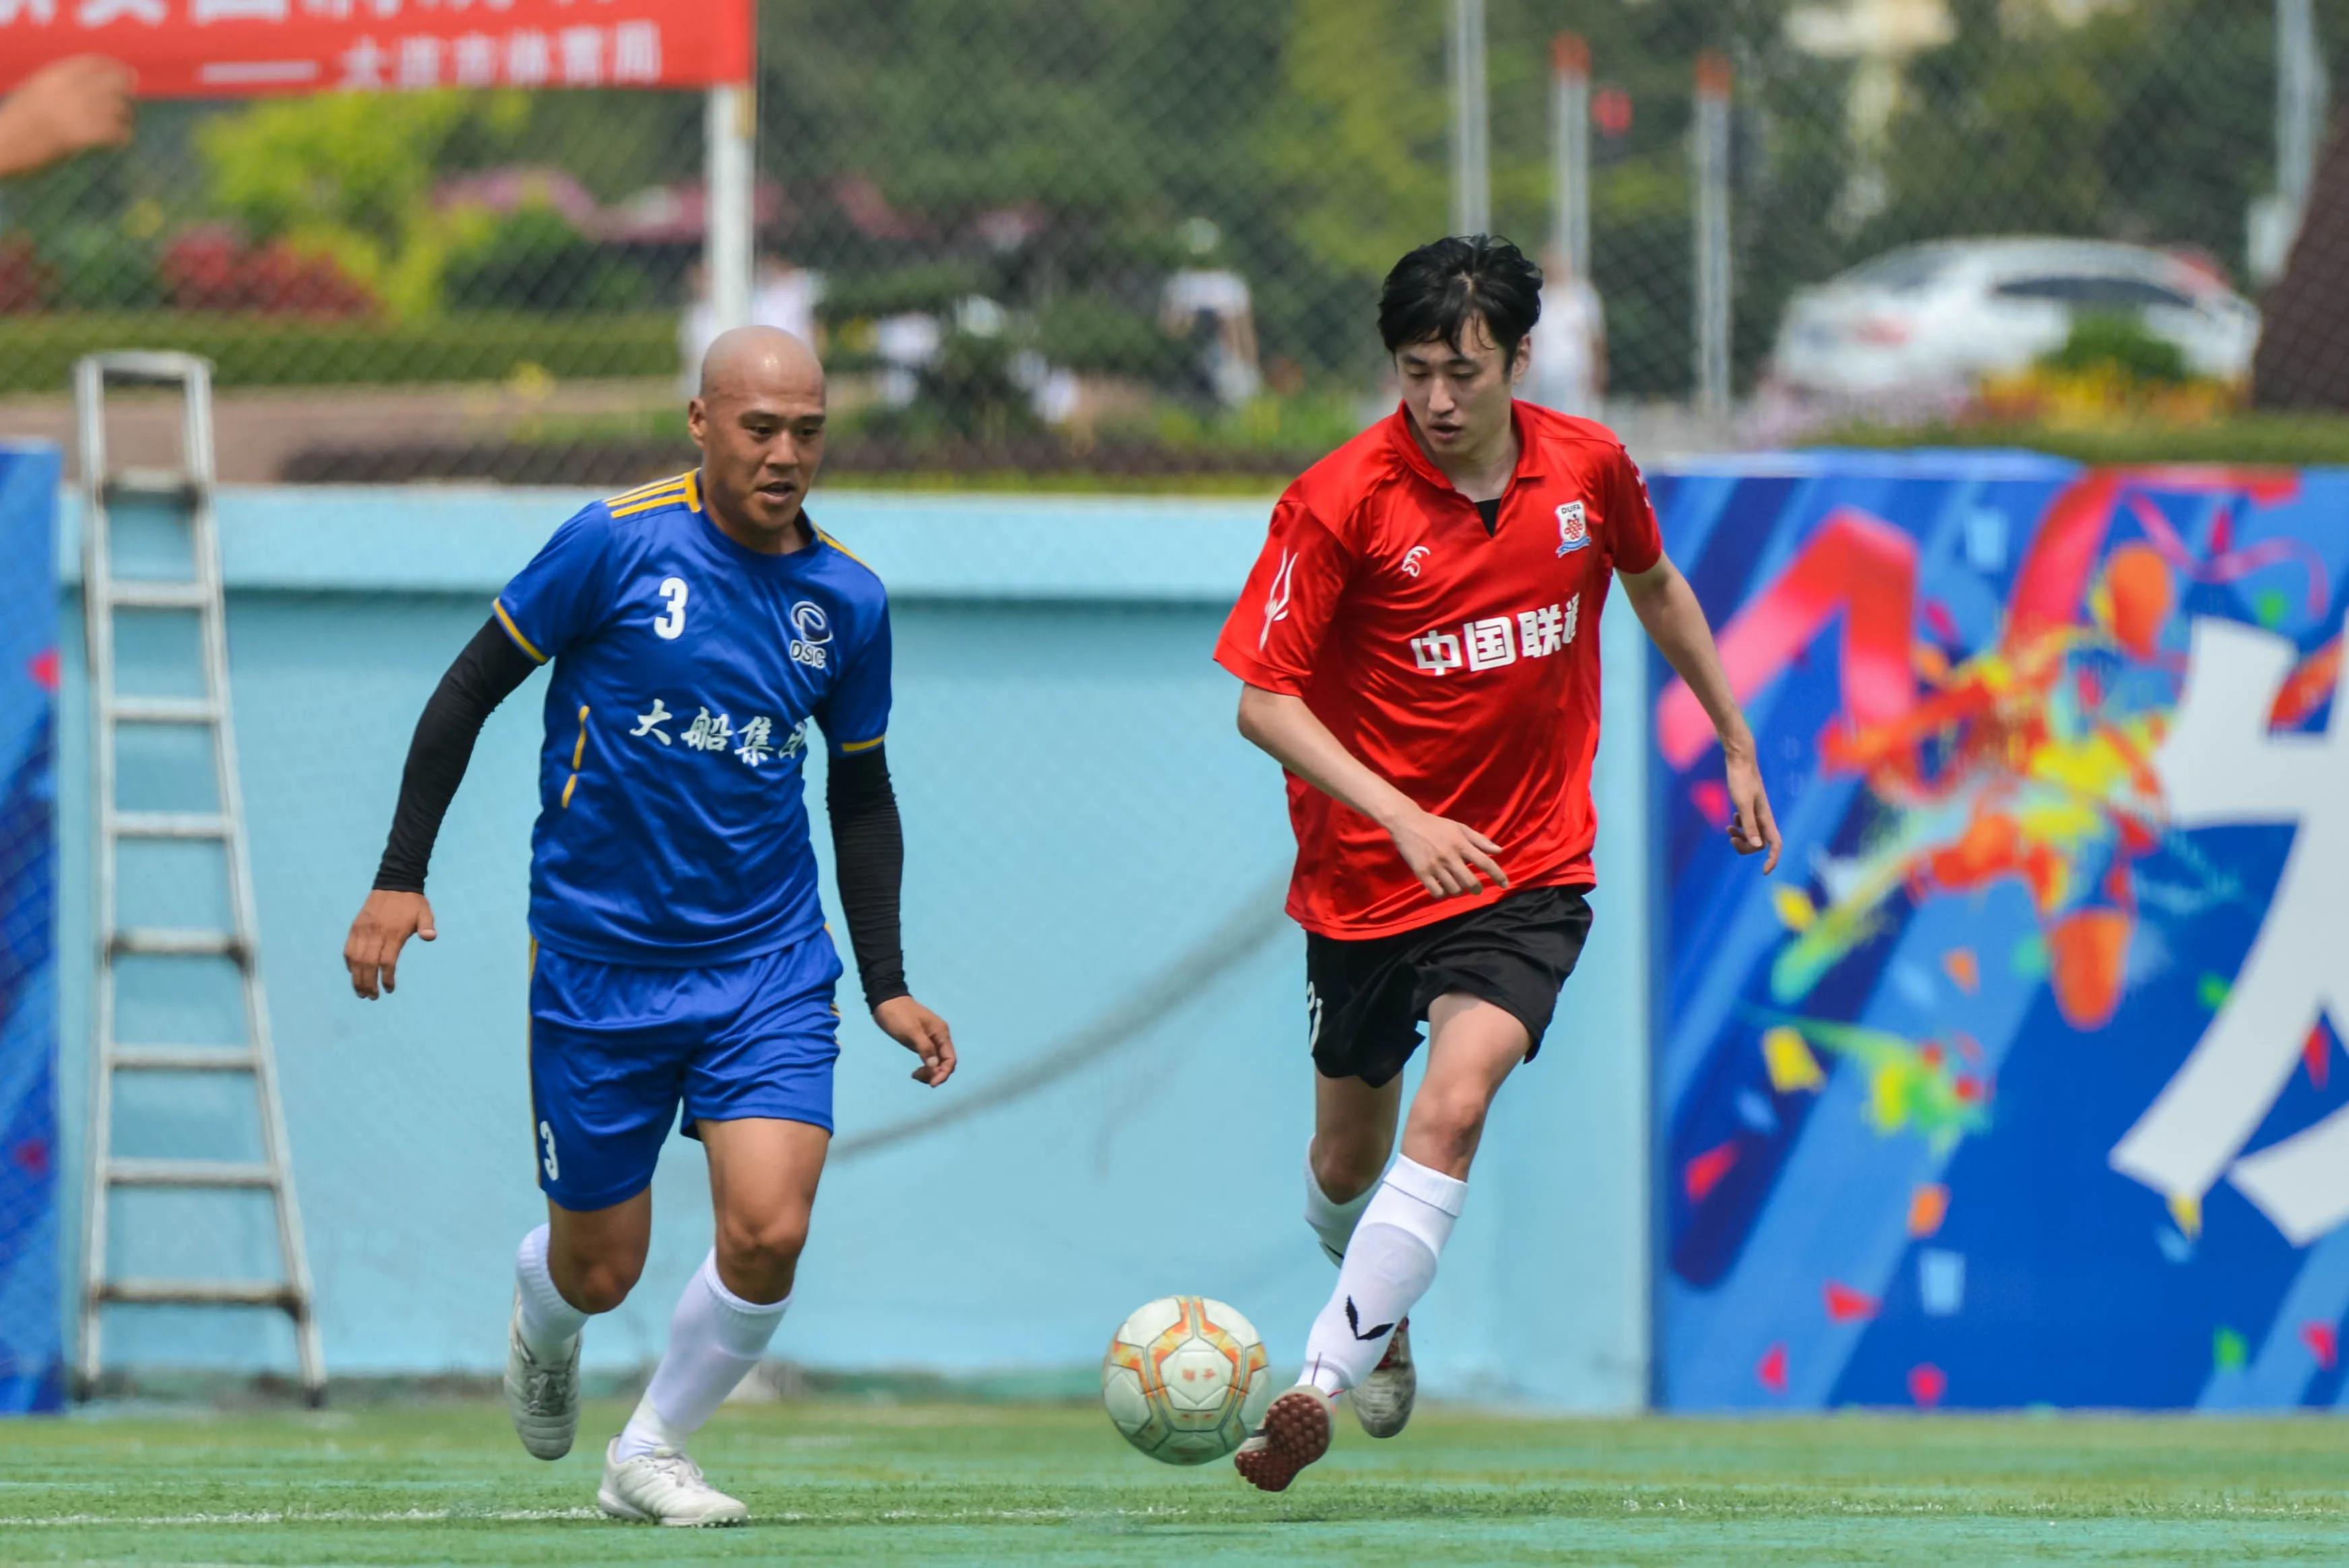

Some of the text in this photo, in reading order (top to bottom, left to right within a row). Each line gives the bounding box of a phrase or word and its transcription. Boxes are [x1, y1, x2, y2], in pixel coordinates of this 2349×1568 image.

[654, 577, 689, 640] 3
[790, 639, 826, 669] DSC
[540, 1121, 559, 1181] 3
